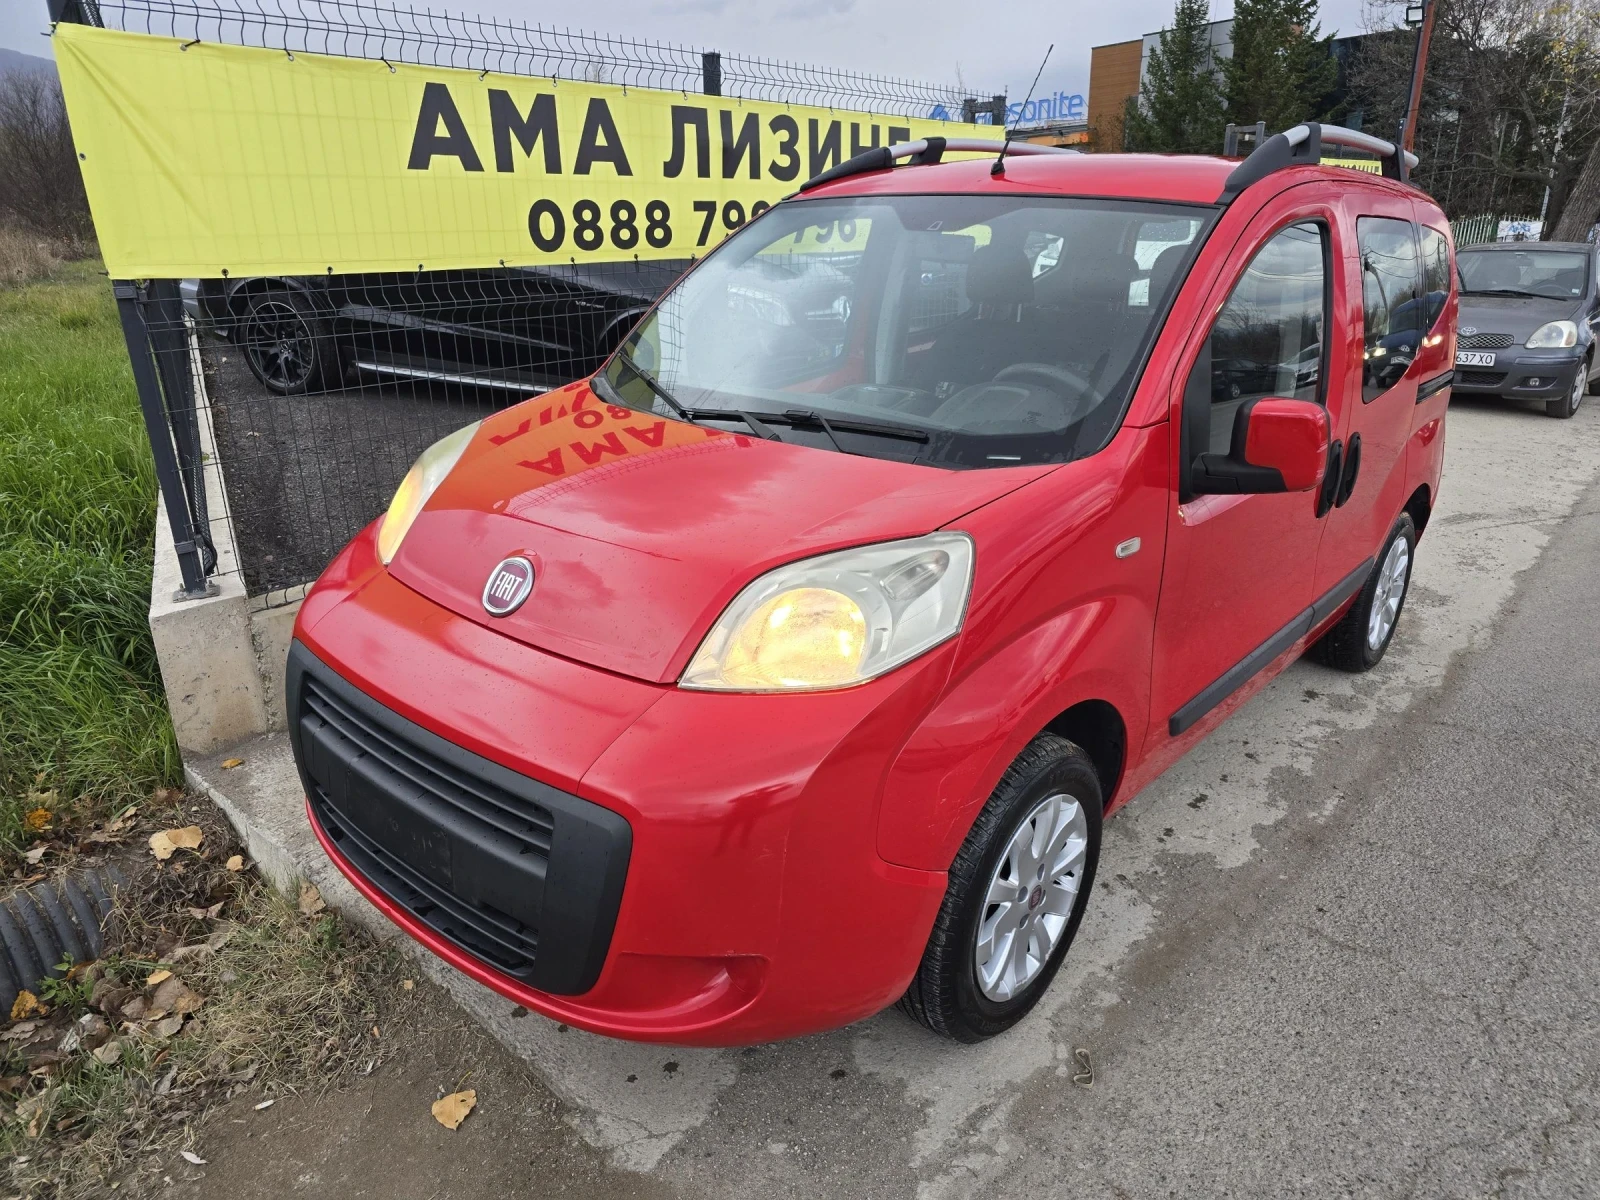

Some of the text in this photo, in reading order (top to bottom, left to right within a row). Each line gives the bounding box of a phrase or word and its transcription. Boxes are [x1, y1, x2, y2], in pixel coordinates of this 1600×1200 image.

[407, 82, 633, 176] АМА
[960, 91, 1083, 125] sonite
[528, 198, 673, 252] 0888
[490, 571, 523, 601] FIAT
